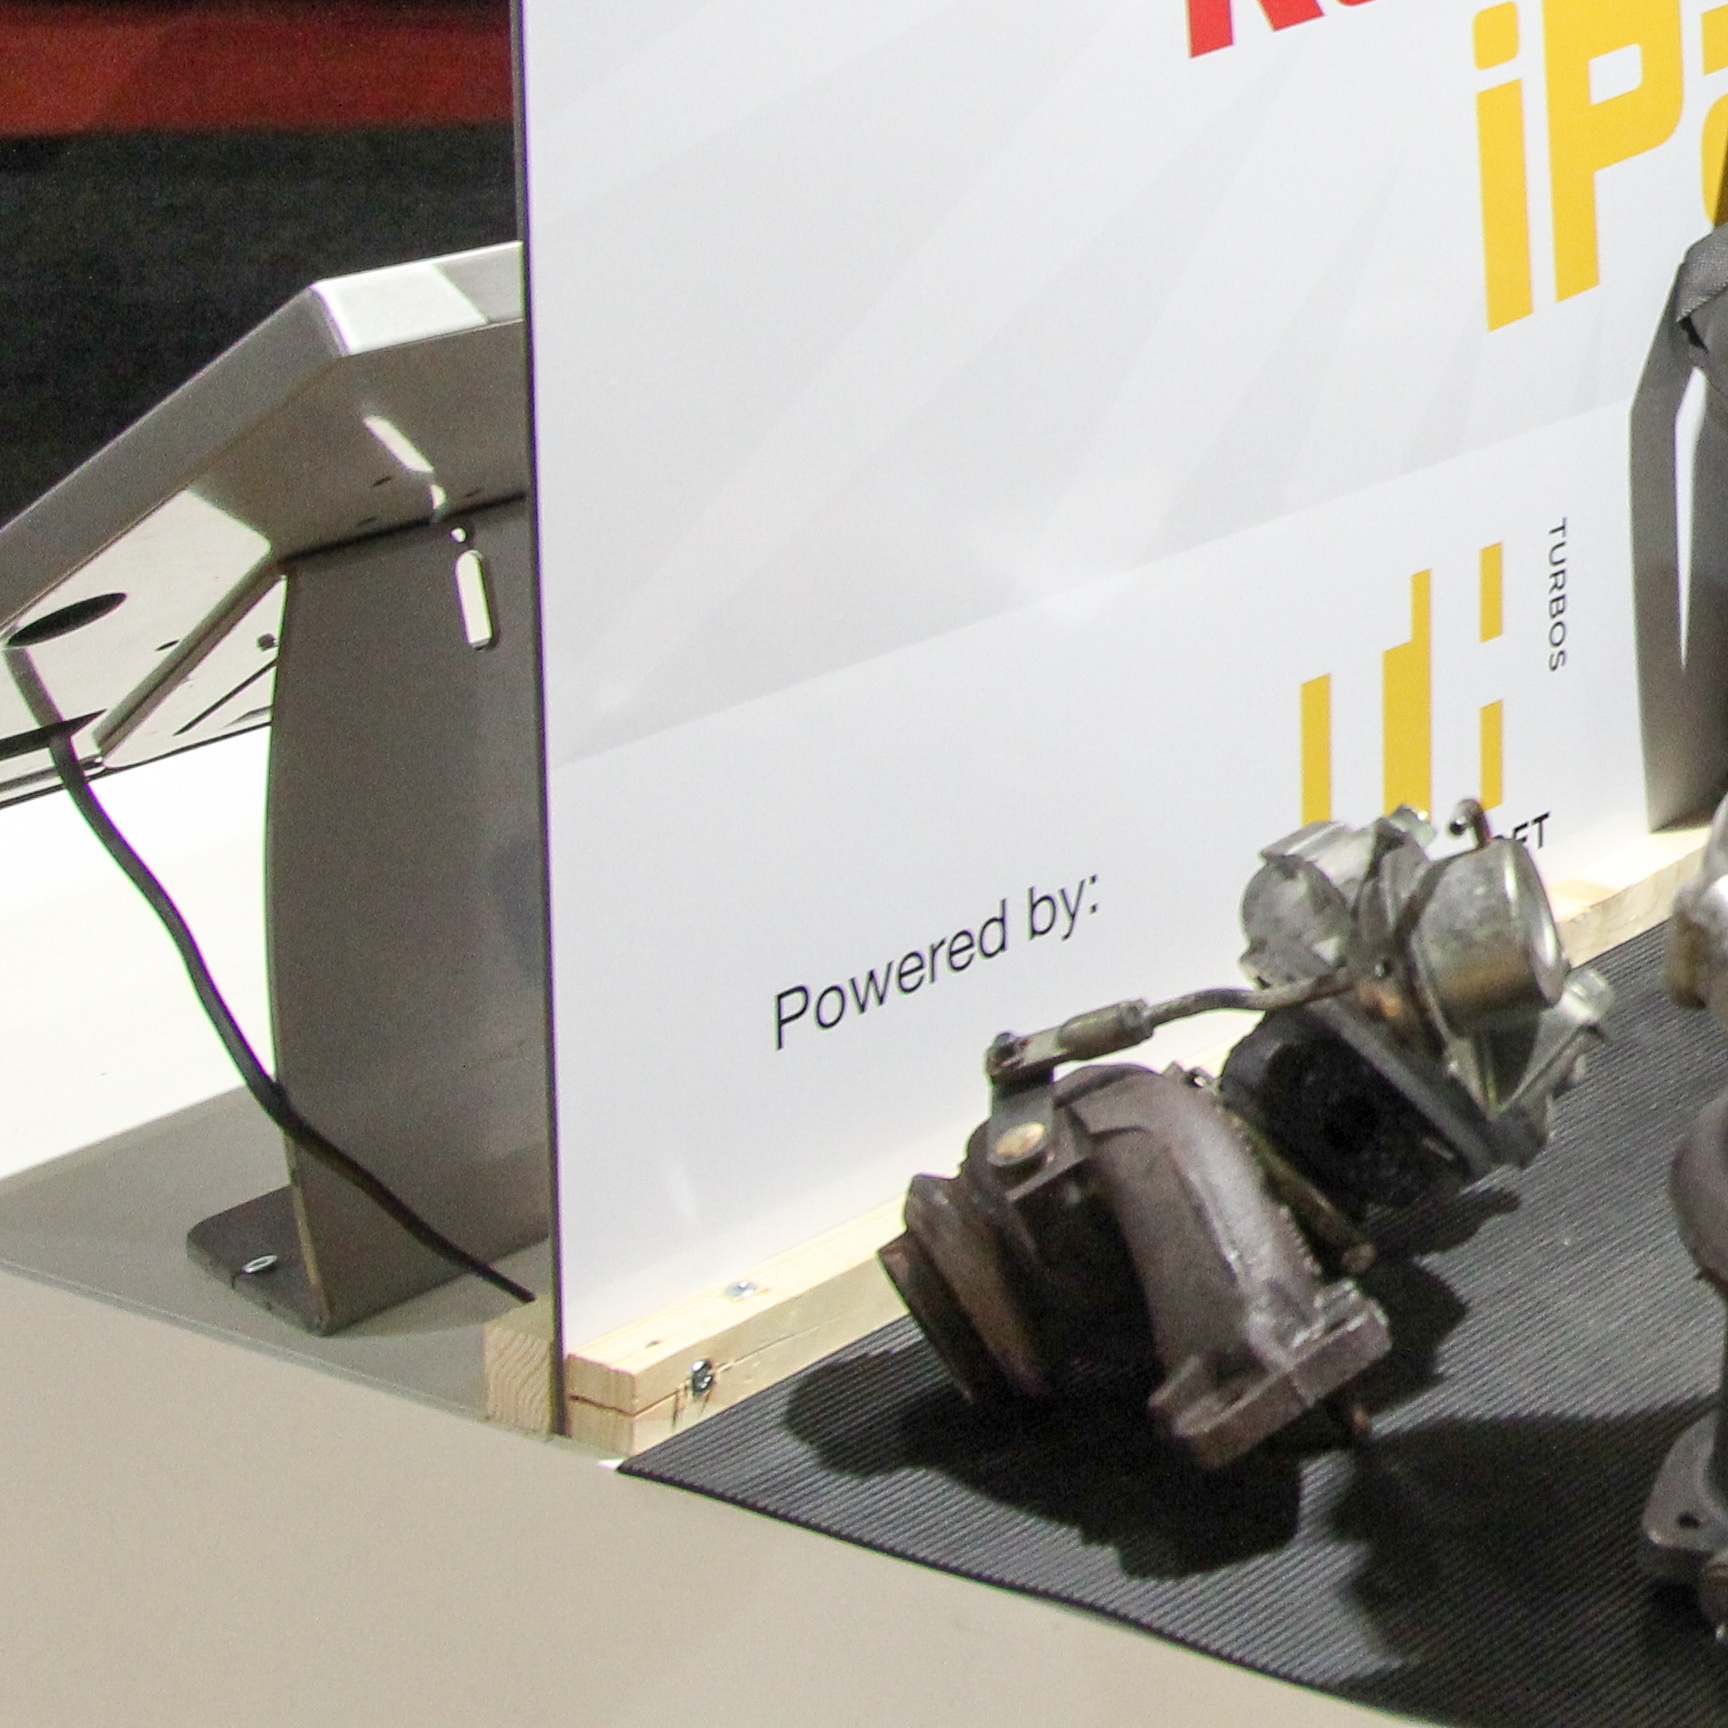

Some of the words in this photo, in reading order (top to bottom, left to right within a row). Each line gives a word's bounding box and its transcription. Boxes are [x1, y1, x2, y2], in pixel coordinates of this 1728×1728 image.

[1548, 516, 1567, 673] TURBOS
[773, 901, 1007, 1050] Powered
[1024, 873, 1101, 944] by:
